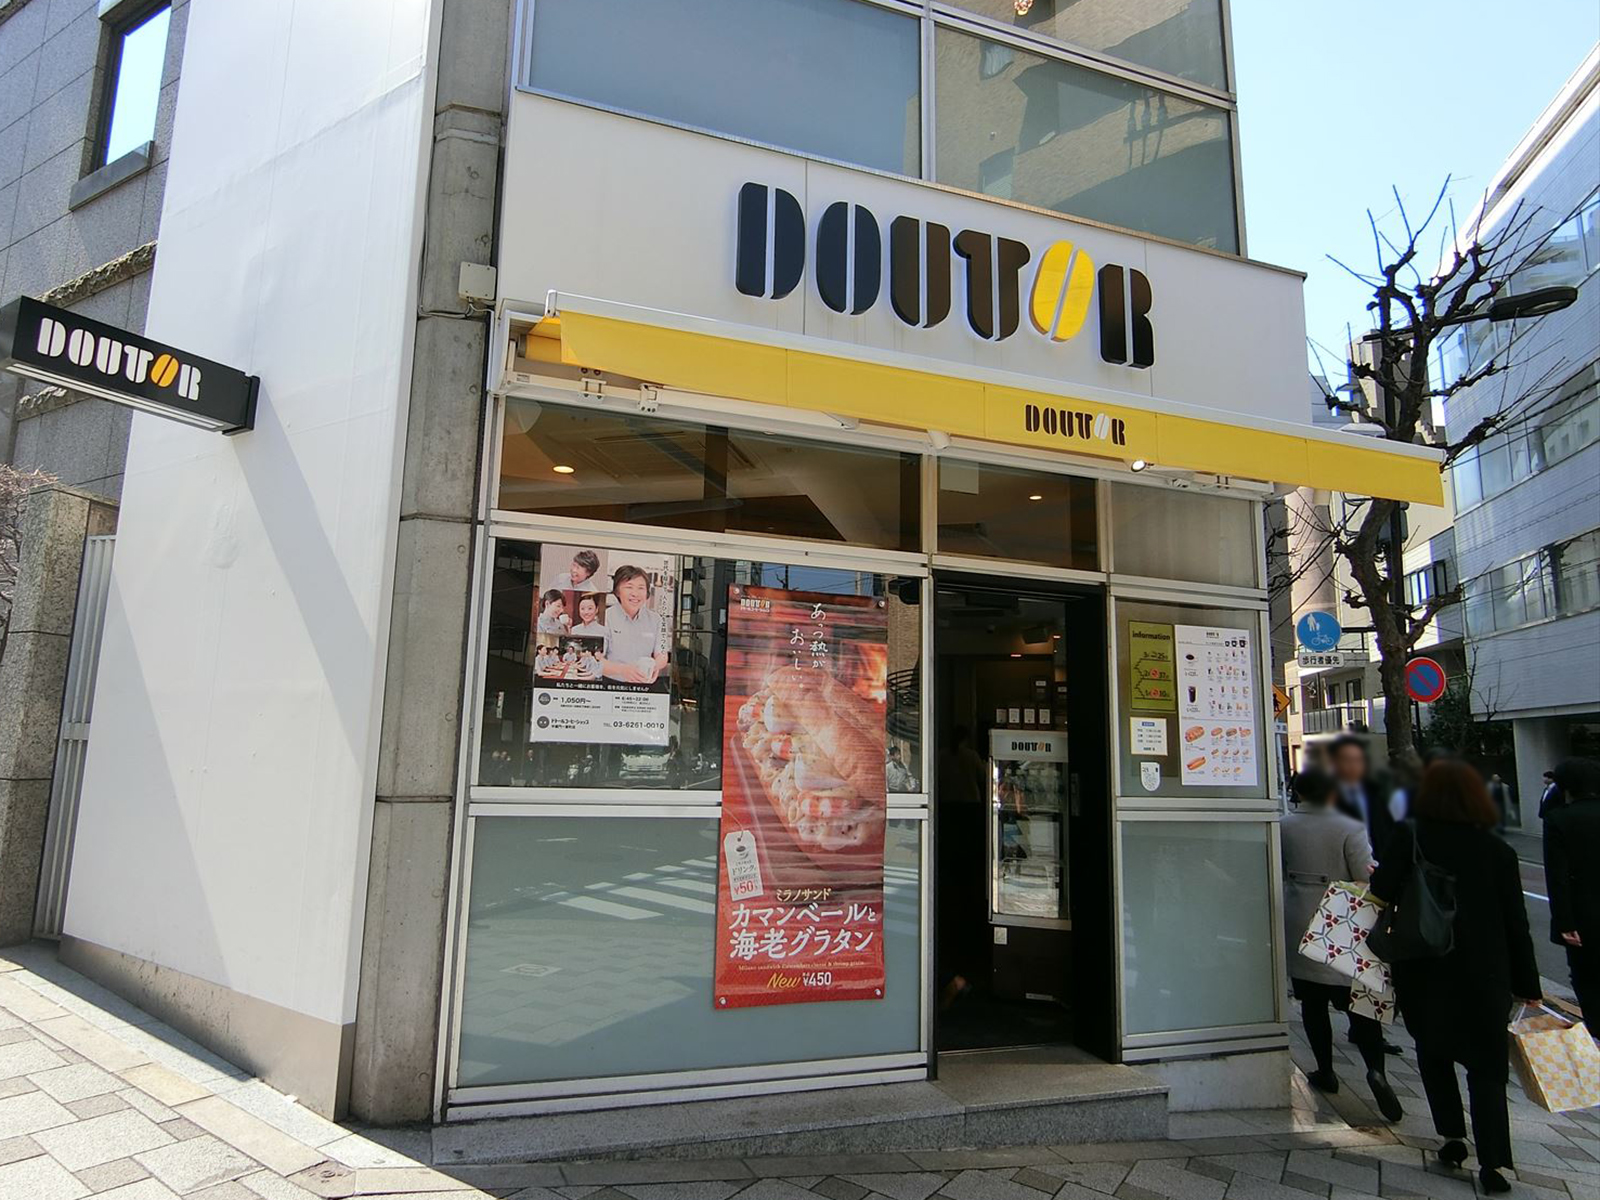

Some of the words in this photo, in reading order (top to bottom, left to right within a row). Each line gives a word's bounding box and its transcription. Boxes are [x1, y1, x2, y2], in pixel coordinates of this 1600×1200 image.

[735, 182, 1155, 369] DOUTOR
[37, 317, 202, 401] DOUTOR
[1025, 404, 1126, 446] DOUTOR
[1132, 631, 1171, 640] information
[1302, 656, 1340, 665] 歩行者優先
[613, 721, 665, 730] 03-6261-0010
[1011, 741, 1052, 753] DOUTOR
[776, 888, 832, 901] ミラノサンド
[729, 902, 877, 930] カマンベールと
[729, 926, 874, 961] 海老グラタン
[767, 972, 801, 989] New
[802, 972, 832, 987] ¥450
